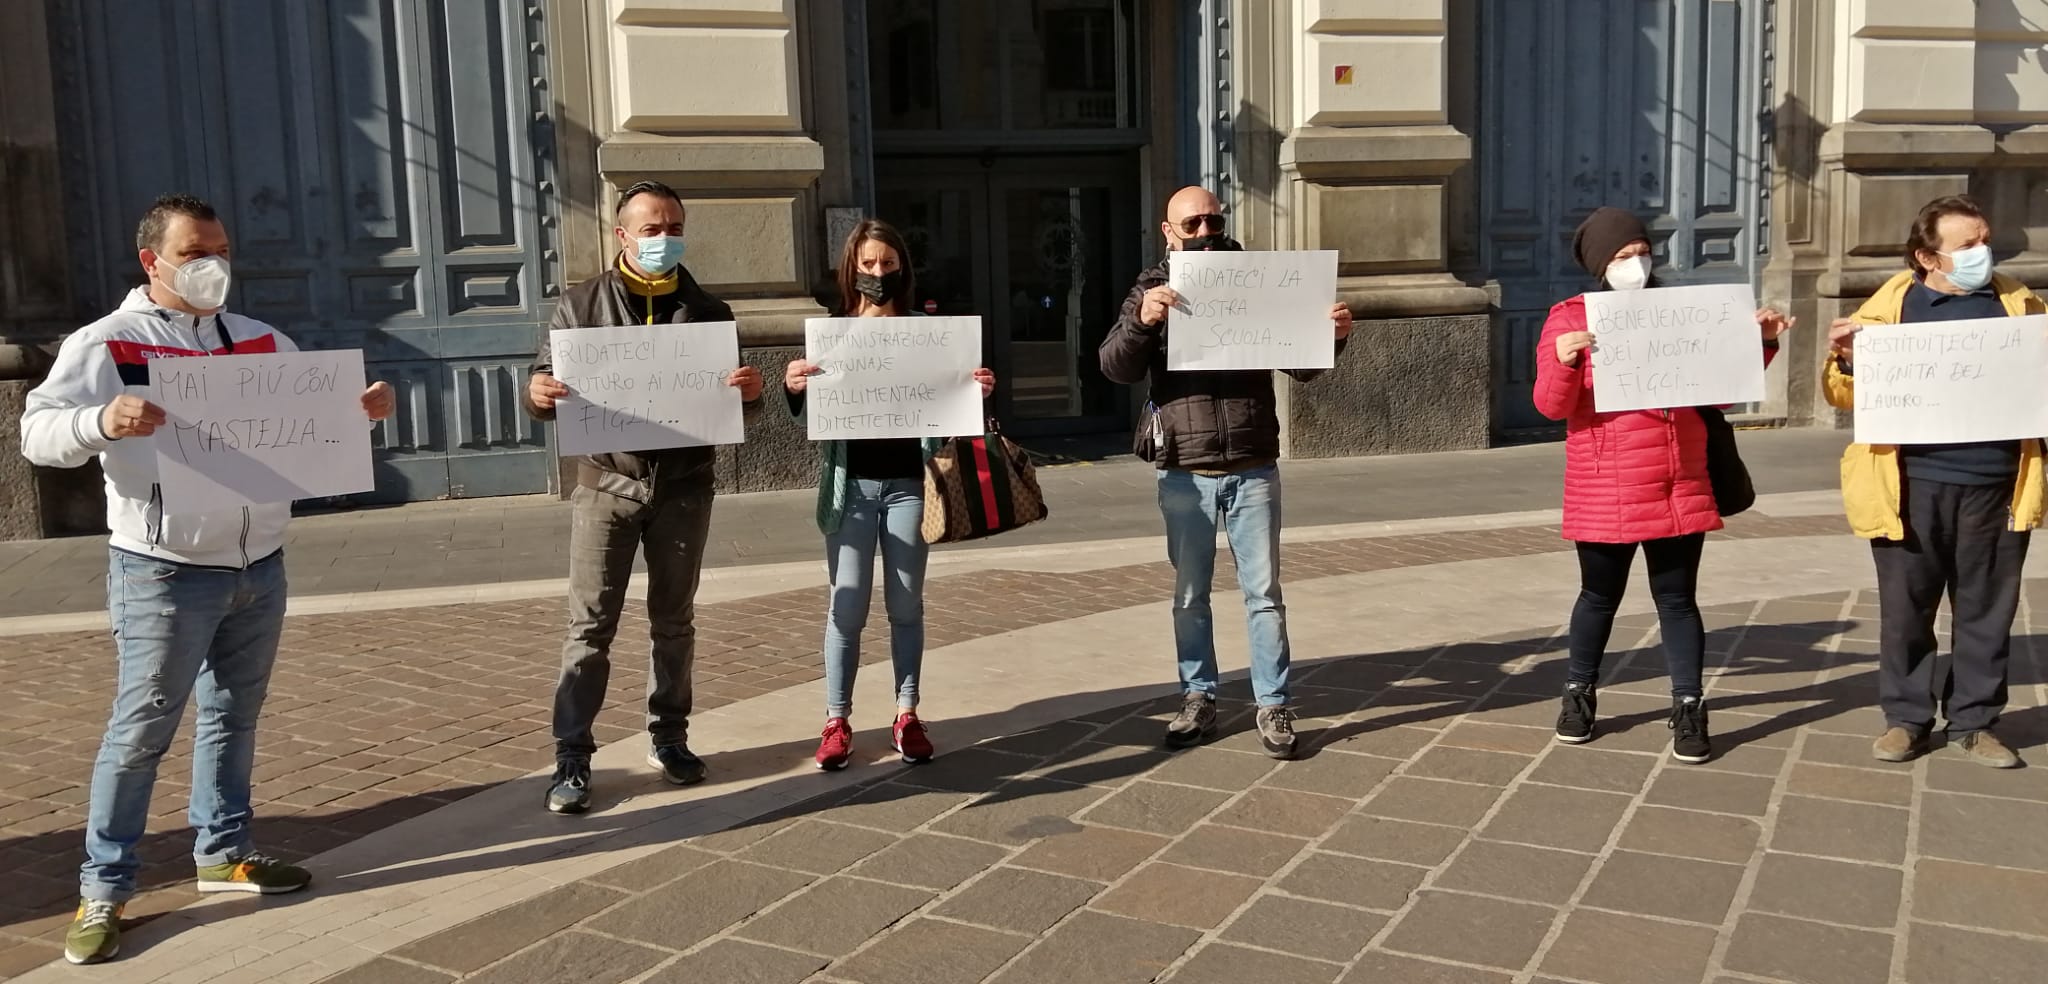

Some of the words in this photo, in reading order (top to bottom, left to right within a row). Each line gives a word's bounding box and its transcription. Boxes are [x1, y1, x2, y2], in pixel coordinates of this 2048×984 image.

[1278, 268, 1304, 288] LA
[1595, 303, 1710, 334] BENEVENTO
[557, 336, 655, 365] RIDATECI
[812, 329, 952, 353] AMMINISTRAZIONE
[1648, 332, 1710, 362] NOSTRI
[1857, 330, 1987, 356] RESTITUITECI
[2000, 329, 2022, 350] LA
[158, 366, 208, 401] MAI
[293, 363, 339, 395] CON
[672, 368, 736, 392] NOSTR
[1950, 361, 1984, 382] DEL
[816, 383, 937, 408] FALLIMENTARE
